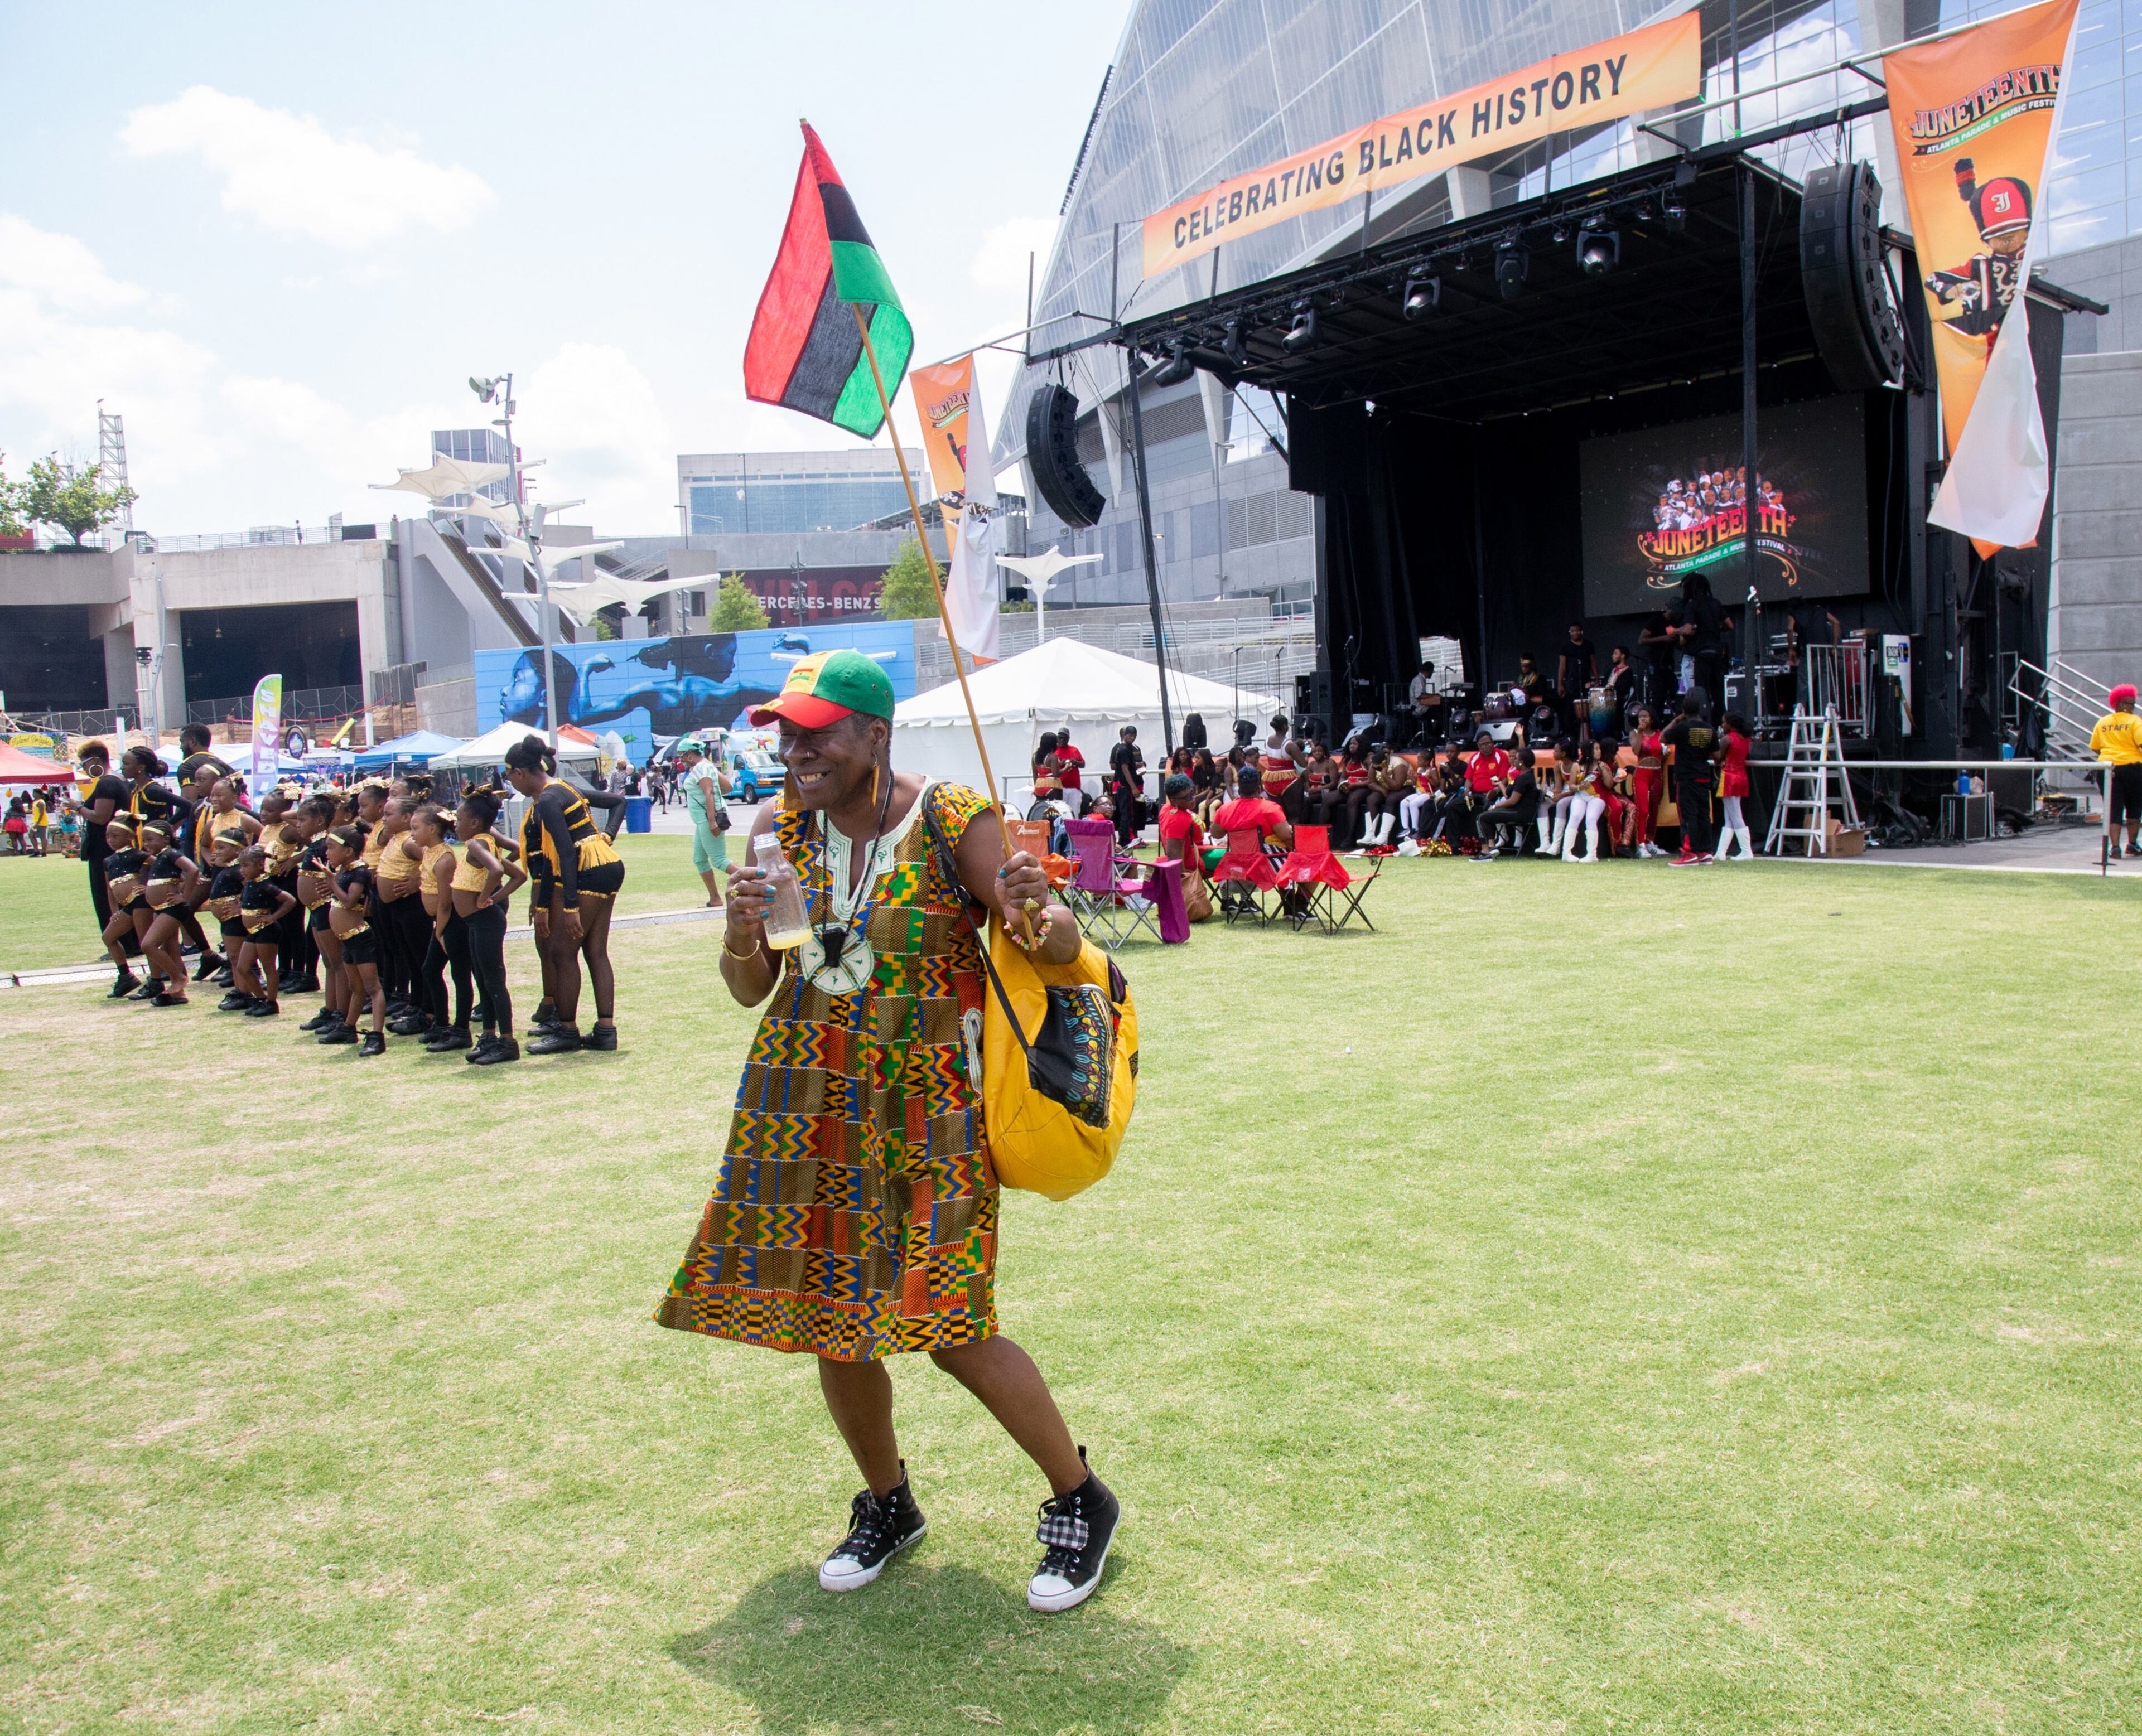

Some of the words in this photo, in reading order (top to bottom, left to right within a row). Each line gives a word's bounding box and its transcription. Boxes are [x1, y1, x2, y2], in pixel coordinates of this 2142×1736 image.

[1911, 65, 2063, 139] JUNETEENTH
[1174, 149, 1344, 249] CELEBRATING
[1359, 109, 1457, 175] BLACK
[1471, 54, 1628, 138] HISTORY
[1927, 136, 1960, 154] ATLANTA
[1961, 122, 1991, 141] PARADE
[1992, 117, 1999, 125] &
[2000, 103, 2027, 120] MUSIC
[1653, 506, 1787, 556] JUNETEETH
[1664, 561, 1694, 572] ATLANTA
[1695, 551, 1721, 565] PARADE
[258, 689, 278, 774] SHAVED
[2101, 723, 2130, 732] STAFF
